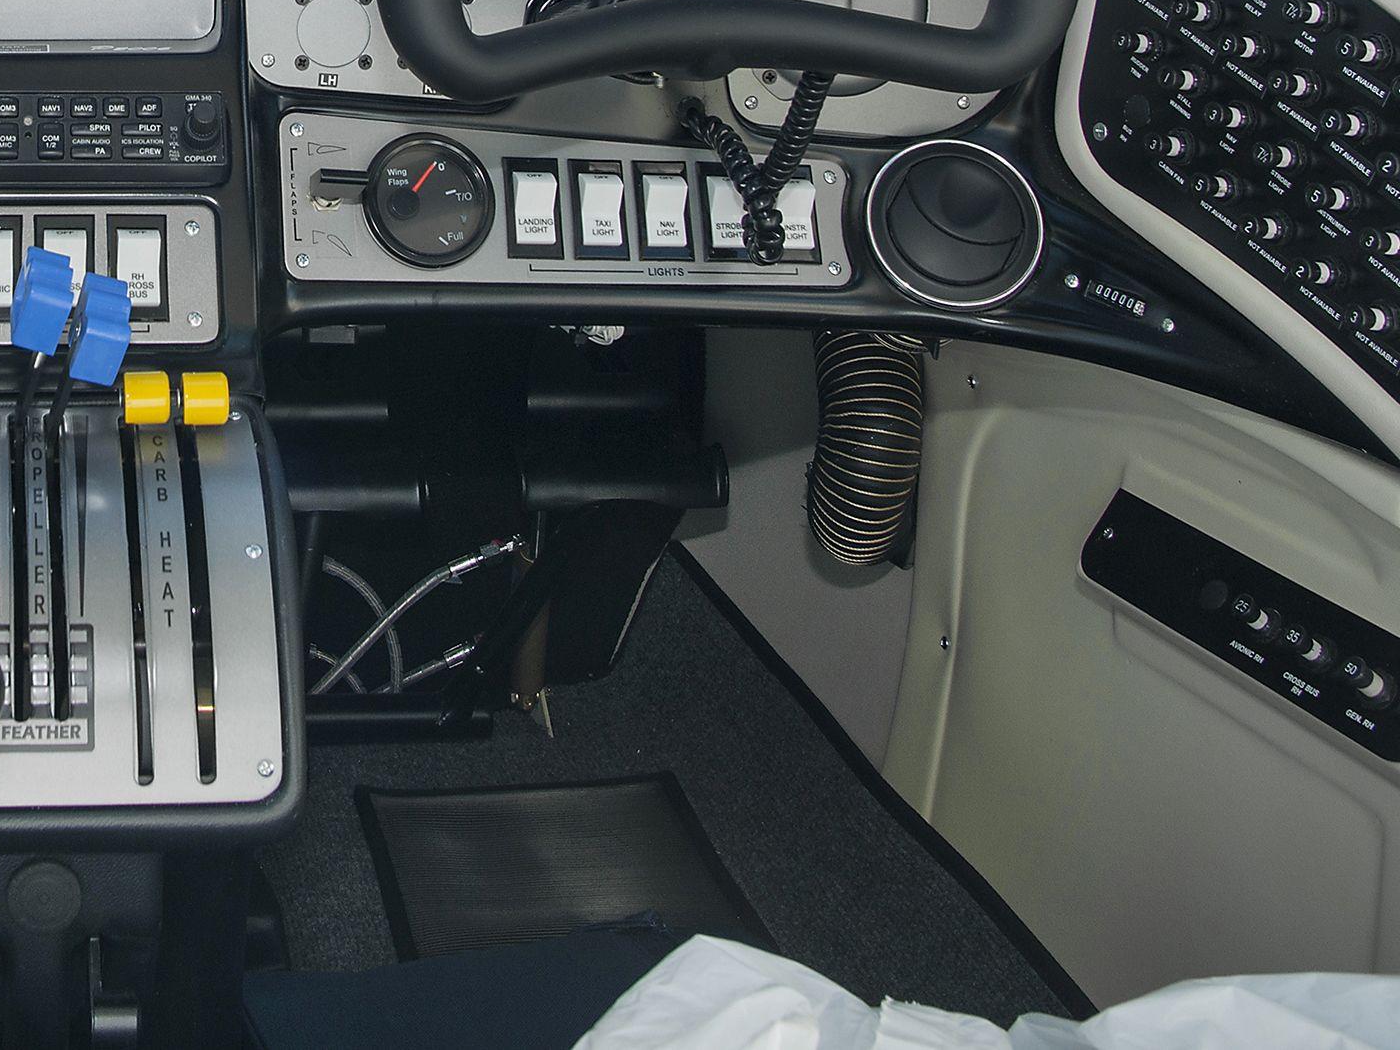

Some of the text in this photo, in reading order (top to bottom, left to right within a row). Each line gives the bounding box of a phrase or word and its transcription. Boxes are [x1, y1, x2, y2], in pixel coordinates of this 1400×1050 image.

[1342, 67, 1358, 81] NOT
[321, 75, 337, 86] LH
[42, 104, 61, 112] NAV1
[74, 104, 93, 112] NAV2
[108, 104, 125, 112] DME
[141, 104, 157, 112] ADF
[89, 124, 111, 132] SPKR
[138, 124, 161, 132] PILOT
[1329, 140, 1345, 154] NOT
[184, 155, 217, 163] COPILOT
[387, 168, 407, 177] Wing
[388, 178, 409, 187] Flaps
[518, 218, 553, 226] LANDING
[595, 220, 611, 228] TAXI
[525, 226, 548, 234] LIGHT
[592, 228, 615, 236] LIGHT
[657, 229, 679, 237] LIGHT
[447, 232, 464, 241] Full
[648, 267, 684, 277] LIGHTS
[131, 273, 145, 281] RH
[129, 290, 148, 298] BUS
[160, 532, 173, 628] HEAT
[1283, 672, 1320, 697] CROSS BUS
[1, 725, 81, 740] FEATHER
